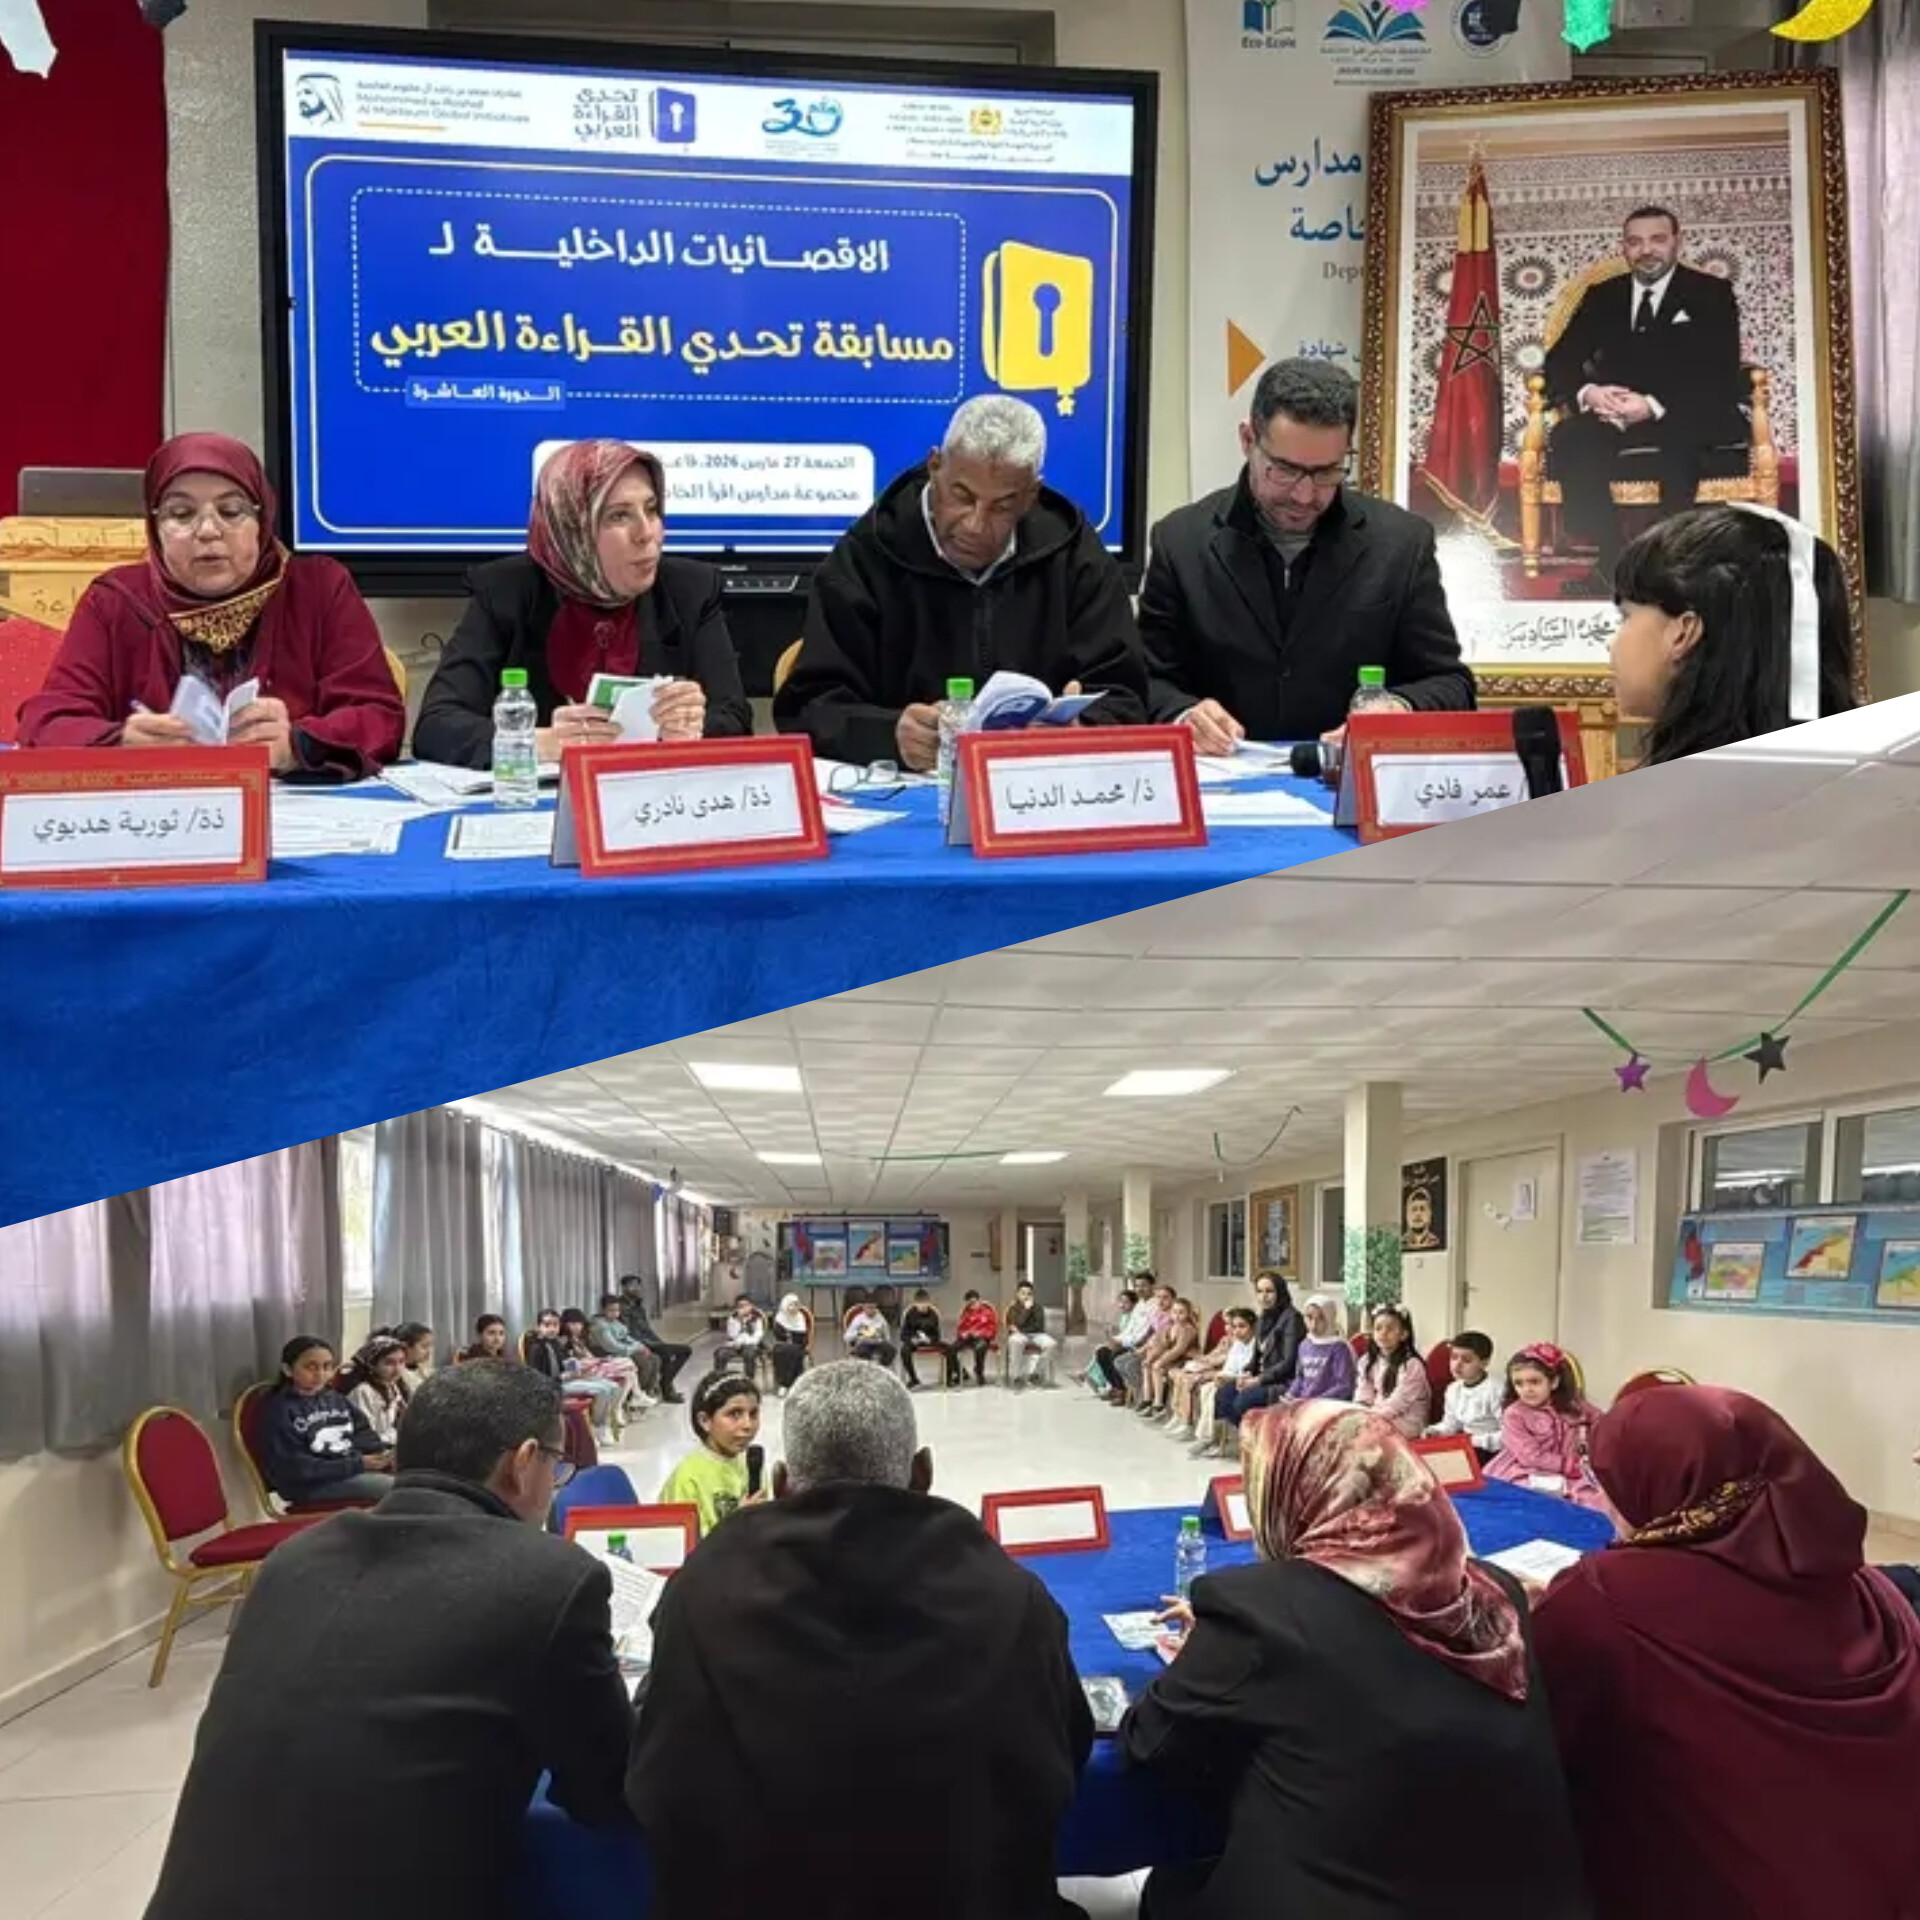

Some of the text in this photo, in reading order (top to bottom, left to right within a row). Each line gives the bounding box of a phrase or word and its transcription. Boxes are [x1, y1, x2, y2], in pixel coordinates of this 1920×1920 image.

[1255, 138, 1362, 187] مدارس
[475, 224, 673, 267] الداخلية
[372, 311, 954, 375] مسابقة تحدي القراءة العربي
[413, 382, 560, 403] الدورة العاشرة
[784, 455, 799, 468] 27
[738, 483, 790, 503] مدارس
[794, 483, 859, 502] مجموعة
[1006, 784, 1063, 815] الدنيا
[1071, 783, 1125, 806] محمد
[1416, 778, 1462, 808] فادي
[1470, 784, 1511, 806] عمر
[119, 808, 179, 837] ثورية
[634, 794, 685, 827] نادري
